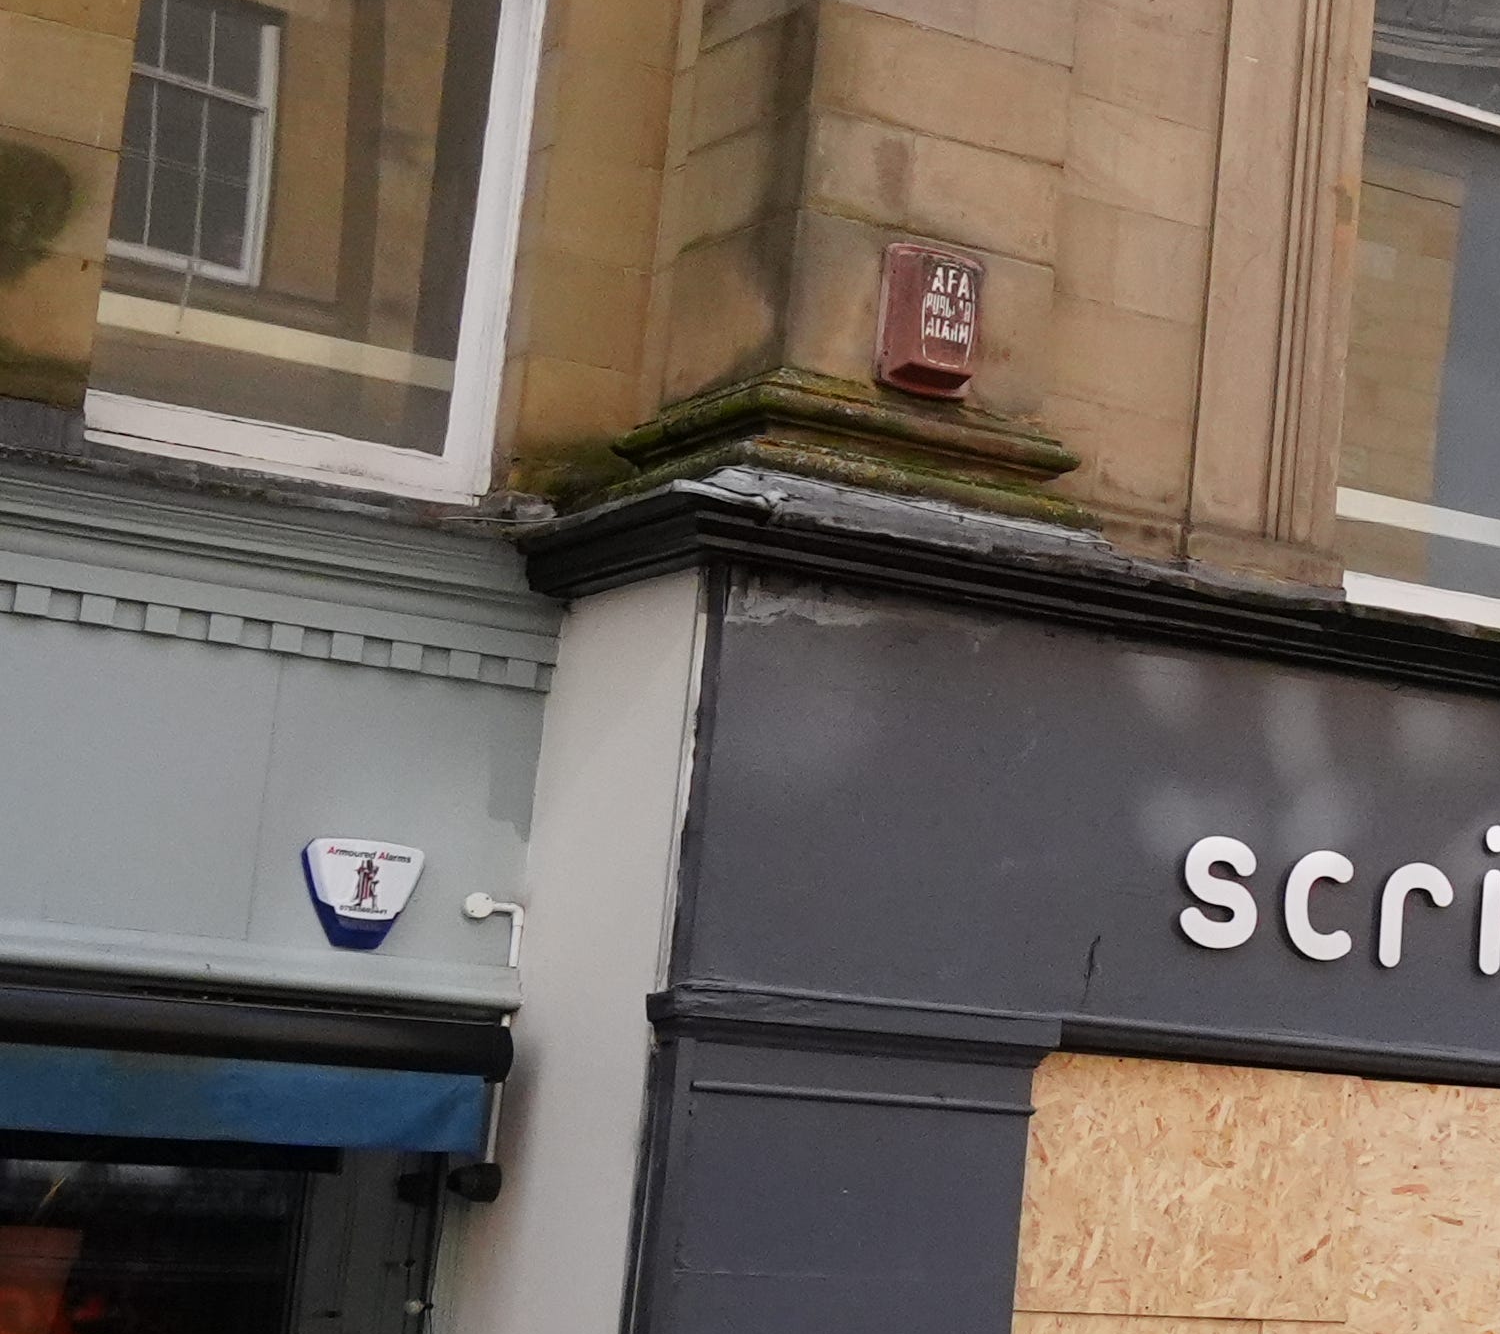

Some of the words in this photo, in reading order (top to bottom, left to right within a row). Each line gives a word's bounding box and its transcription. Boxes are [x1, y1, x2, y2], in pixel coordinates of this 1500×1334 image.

[931, 266, 970, 301] AFA
[326, 846, 377, 860] Armoured
[377, 851, 412, 864] Alarms
